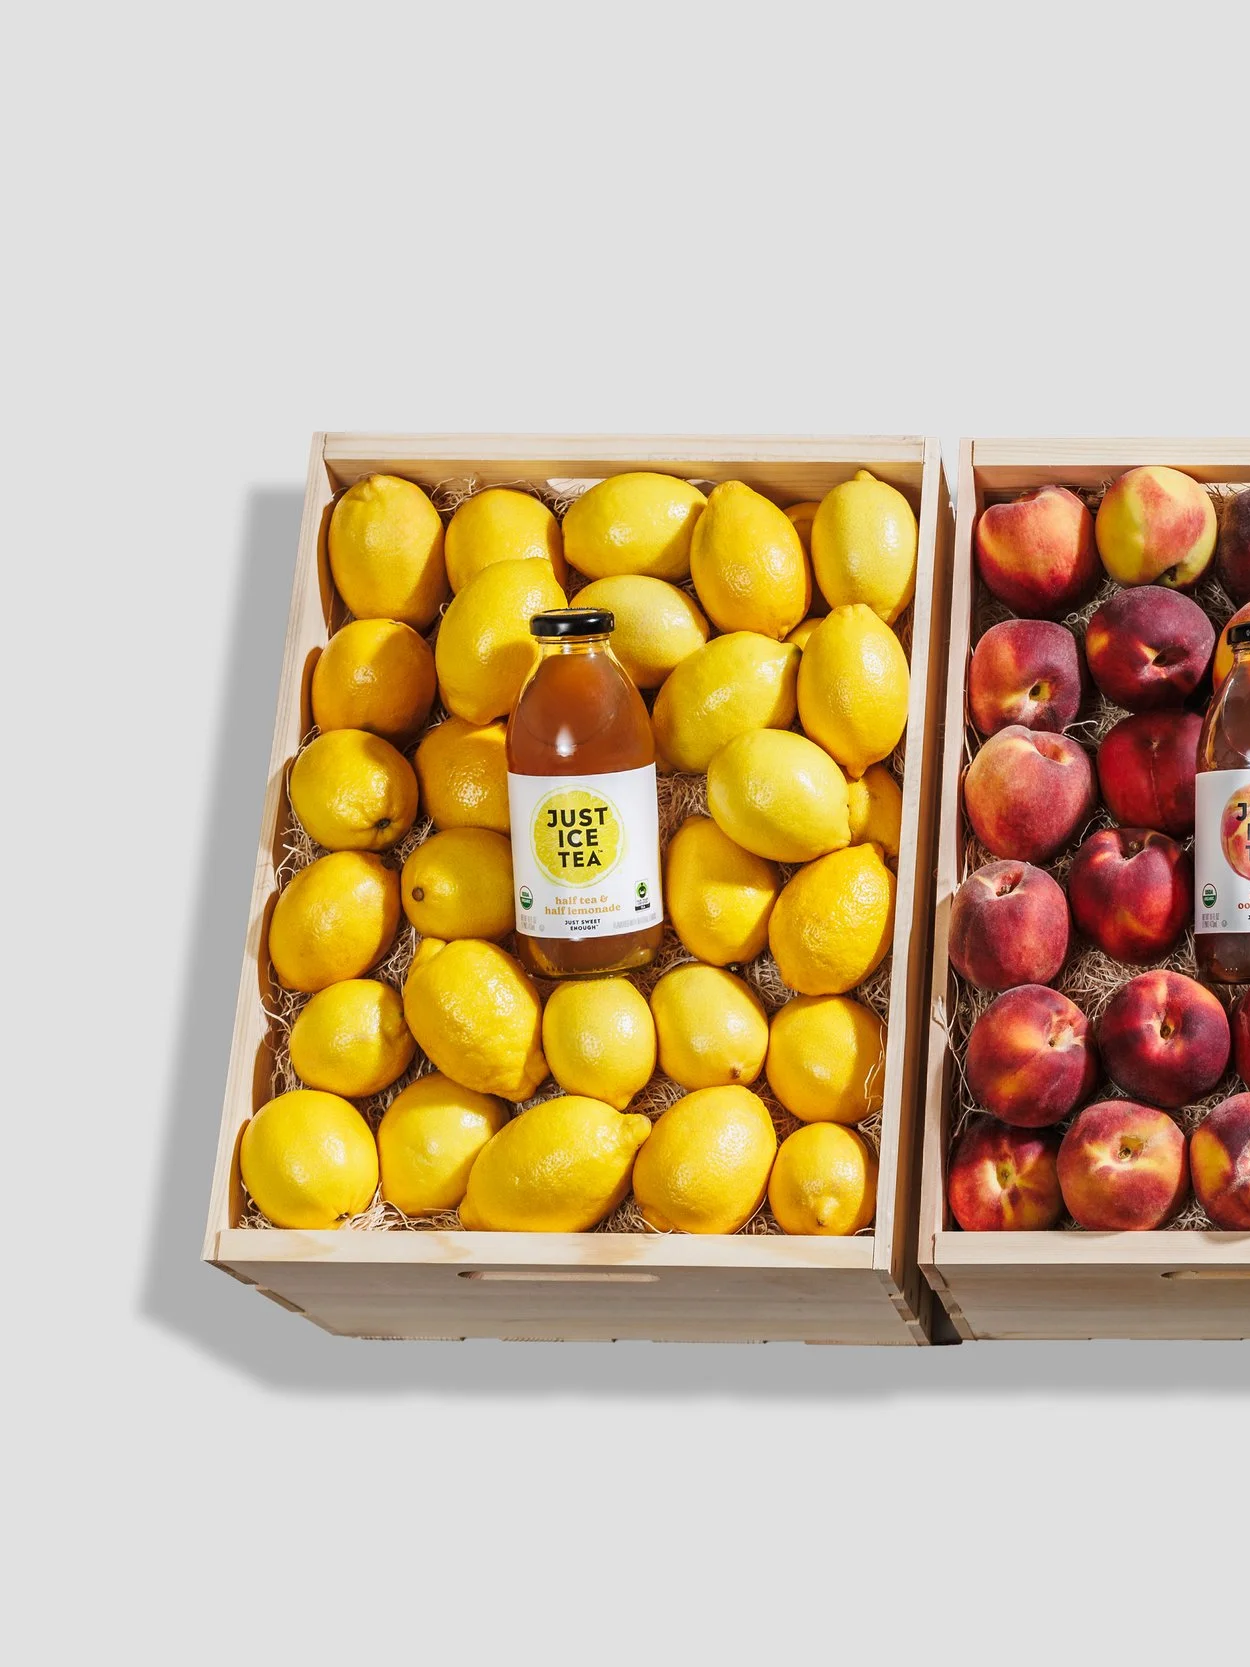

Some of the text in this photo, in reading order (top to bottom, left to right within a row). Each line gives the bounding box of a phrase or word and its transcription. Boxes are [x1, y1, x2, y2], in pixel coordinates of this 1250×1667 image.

[547, 807, 608, 828] JUST
[558, 828, 599, 848] ICE
[555, 894, 609, 905] half tea &
[544, 904, 621, 915] half lemonade
